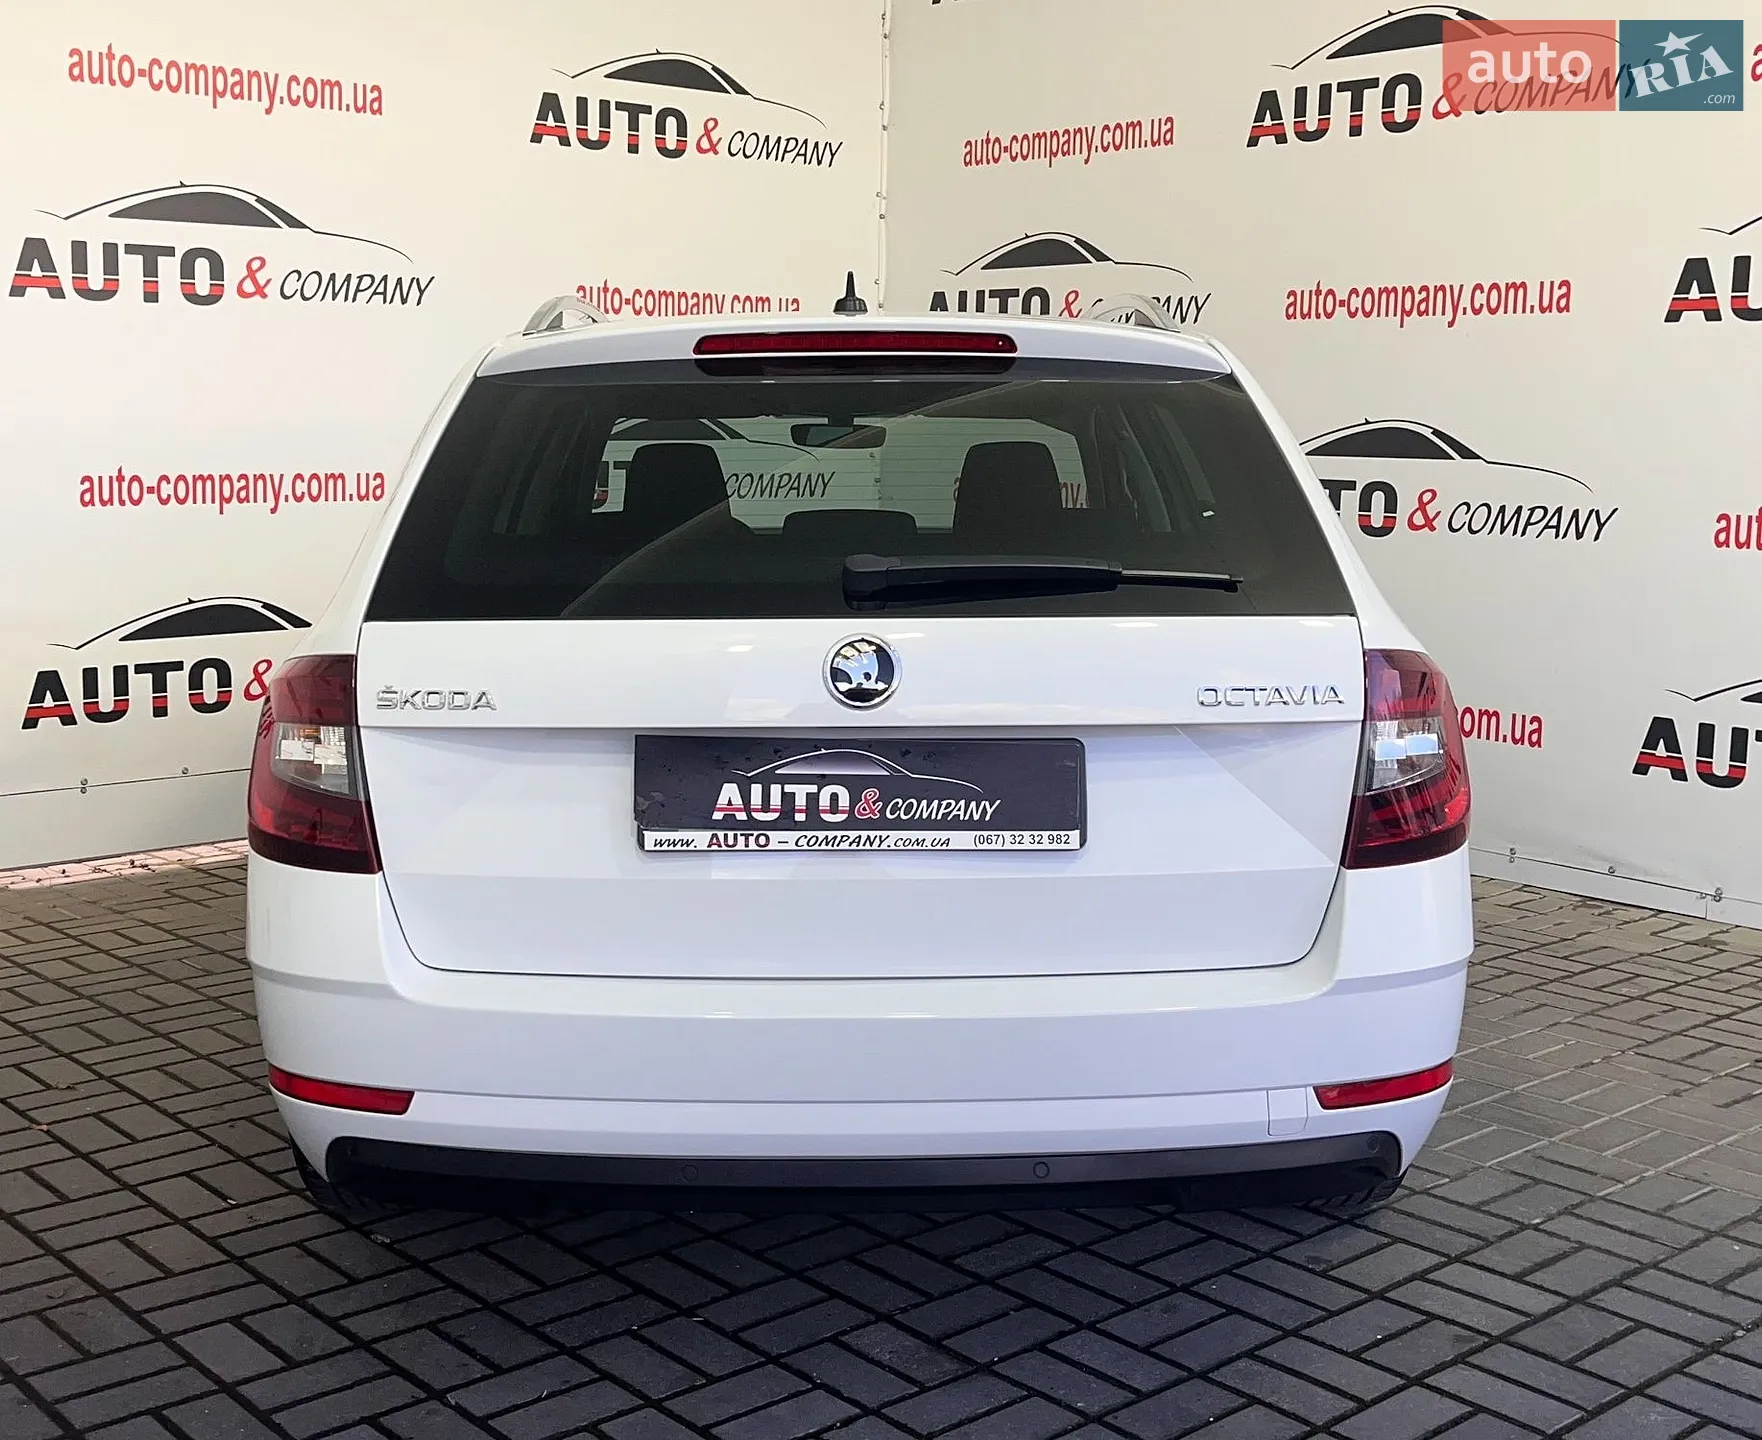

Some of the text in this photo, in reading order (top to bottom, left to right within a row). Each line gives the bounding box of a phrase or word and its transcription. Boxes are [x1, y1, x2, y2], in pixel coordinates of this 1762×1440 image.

[68, 43, 383, 115] auto-company.com.ua
[529, 92, 843, 168] AUTO & COMPANY
[1246, 72, 1422, 148] AUTO
[1432, 72, 1467, 120] &
[962, 113, 1175, 168] auto-company.com.ua
[9, 238, 434, 306] AUTO & COMPANY
[1285, 279, 1572, 328] auto-company.com.ua
[80, 465, 385, 514] auto-company.com.ua
[725, 471, 836, 499] COMPANY
[1407, 488, 1442, 533] &
[1447, 501, 1619, 542] COMPANY
[21, 657, 233, 730] AUTO
[376, 685, 498, 711] ŠKODA
[1197, 684, 1345, 707] OCTAVIA
[712, 783, 1001, 823] AUTO & COMPANY
[653, 837, 698, 848] www.
[706, 833, 771, 849] AUTO
[973, 834, 1006, 847] (067)
[1010, 834, 1025, 845] 32
[1029, 834, 1044, 845] 32
[1047, 834, 1070, 845] 982
